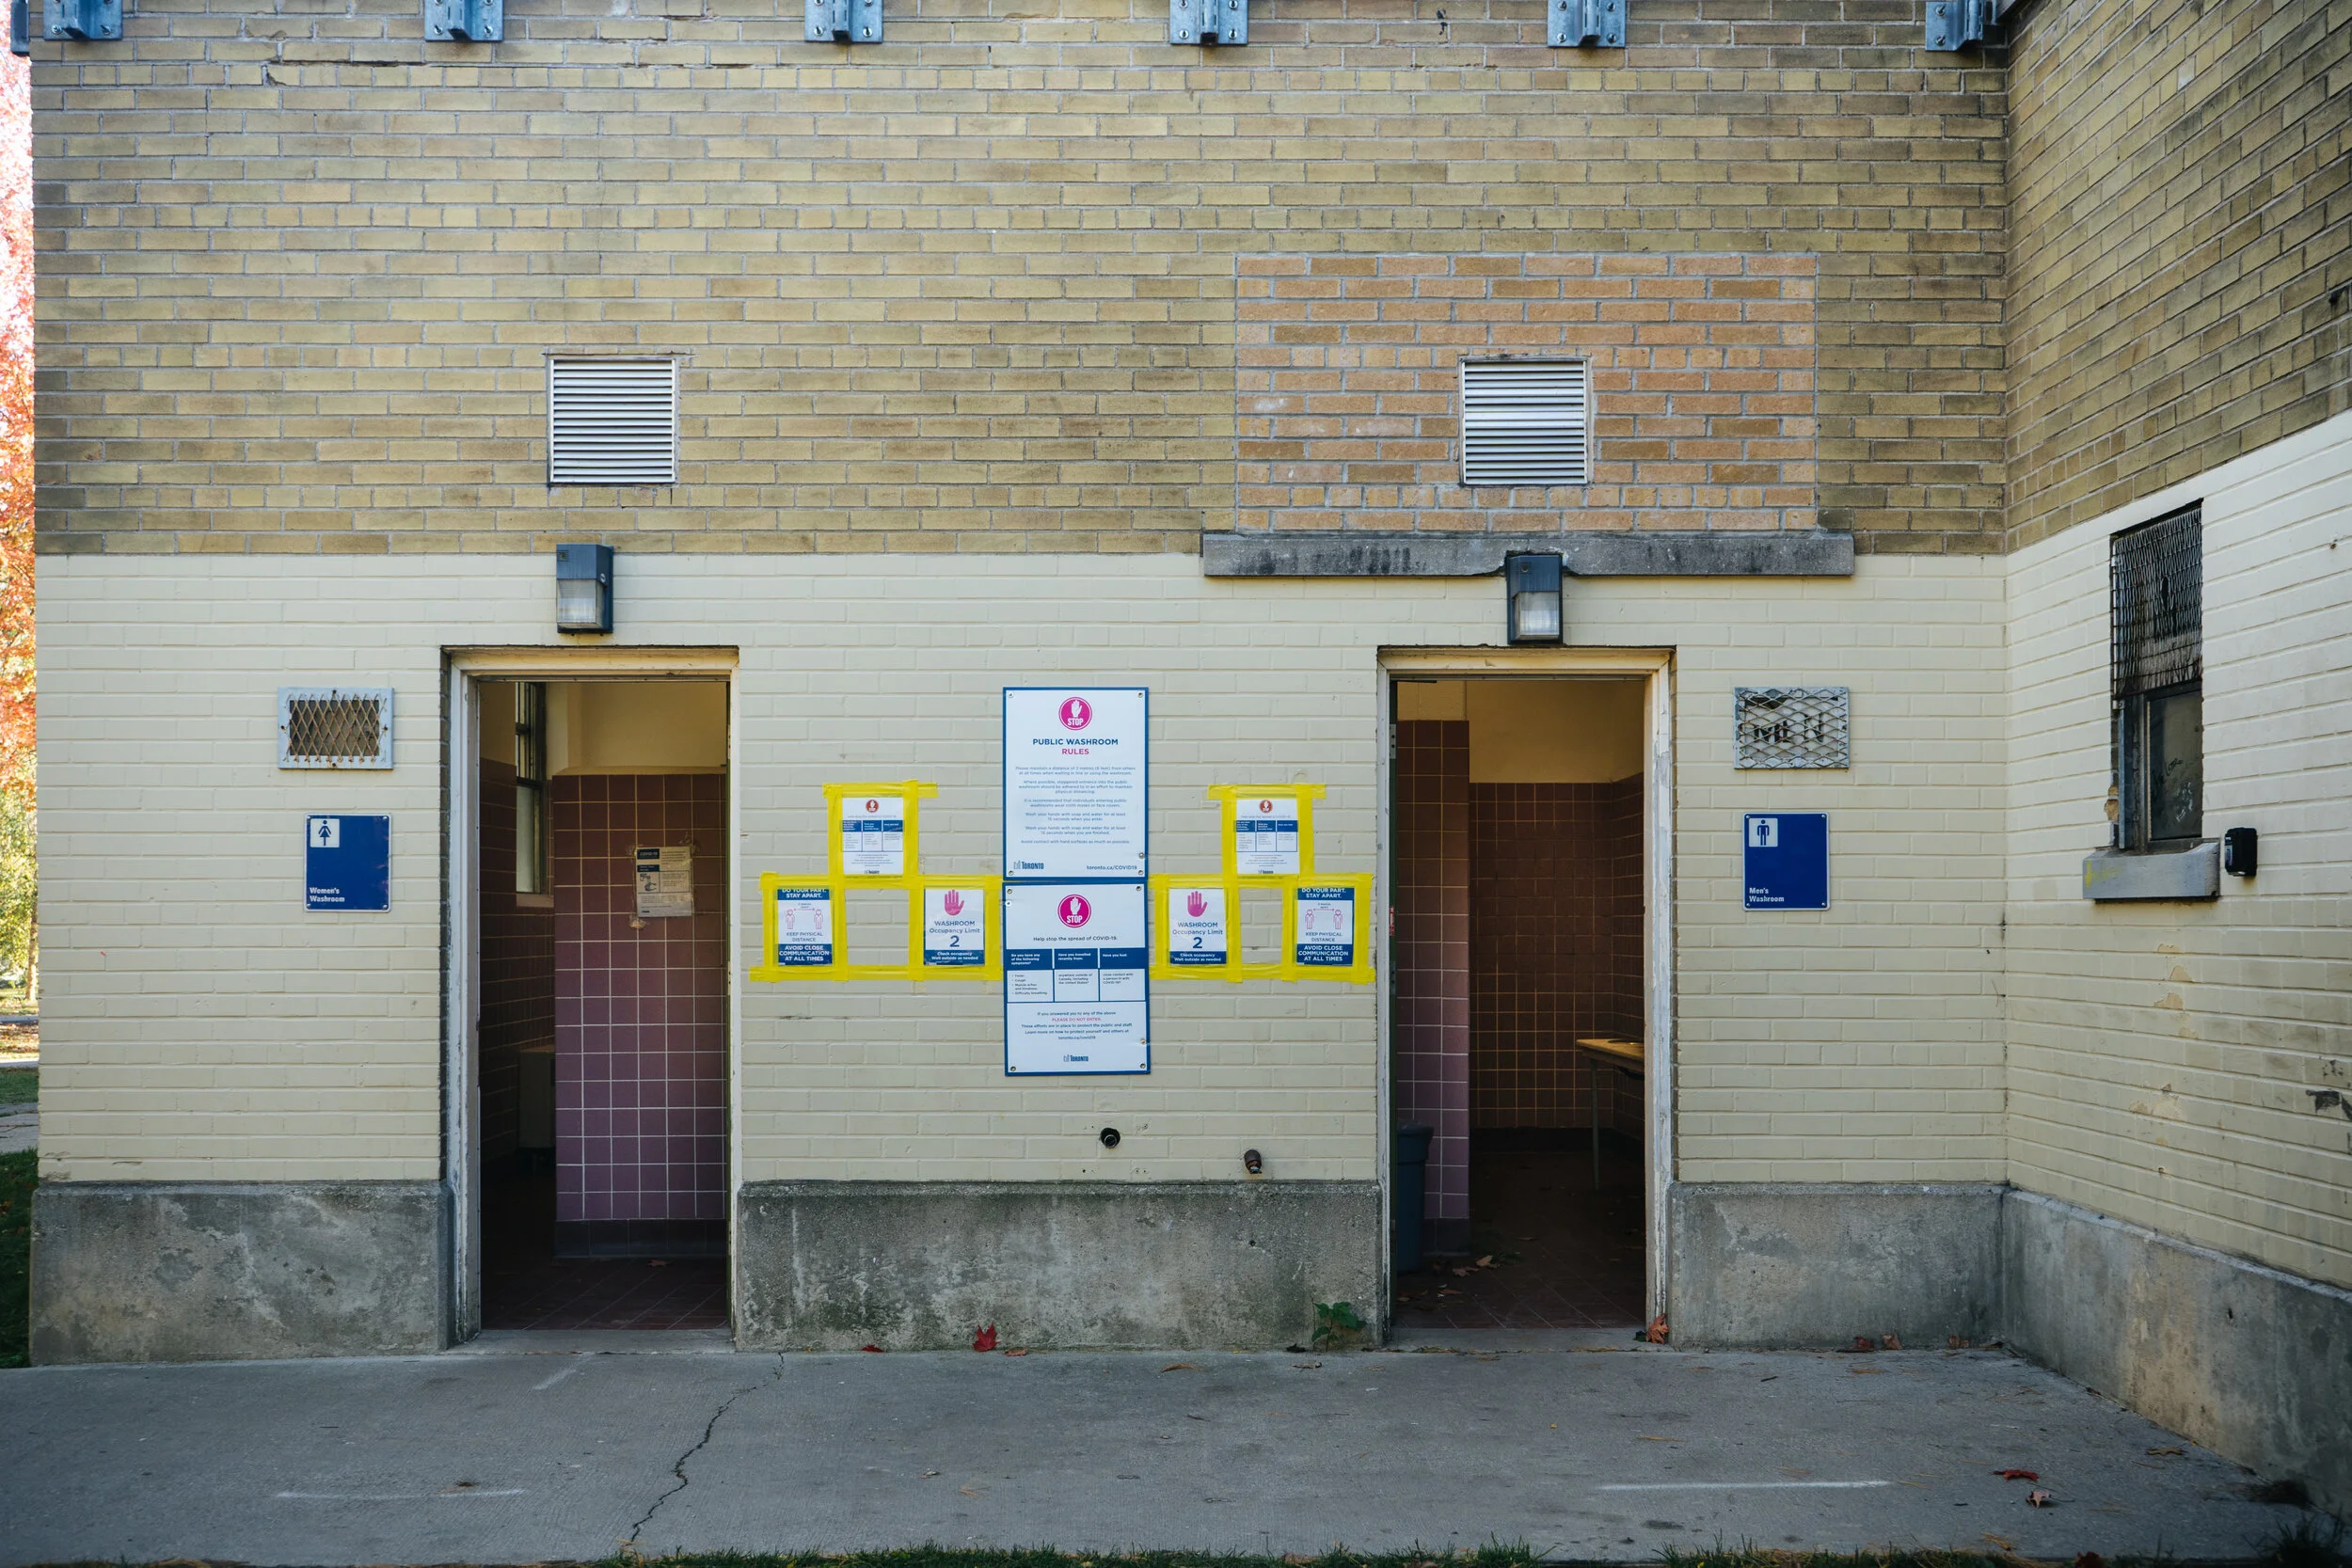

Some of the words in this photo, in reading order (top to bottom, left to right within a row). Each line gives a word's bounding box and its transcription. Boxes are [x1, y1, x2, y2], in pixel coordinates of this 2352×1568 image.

[1066, 915, 1082, 923] STOP
[950, 935, 960, 947] 2
[1193, 936, 1203, 948] 2
